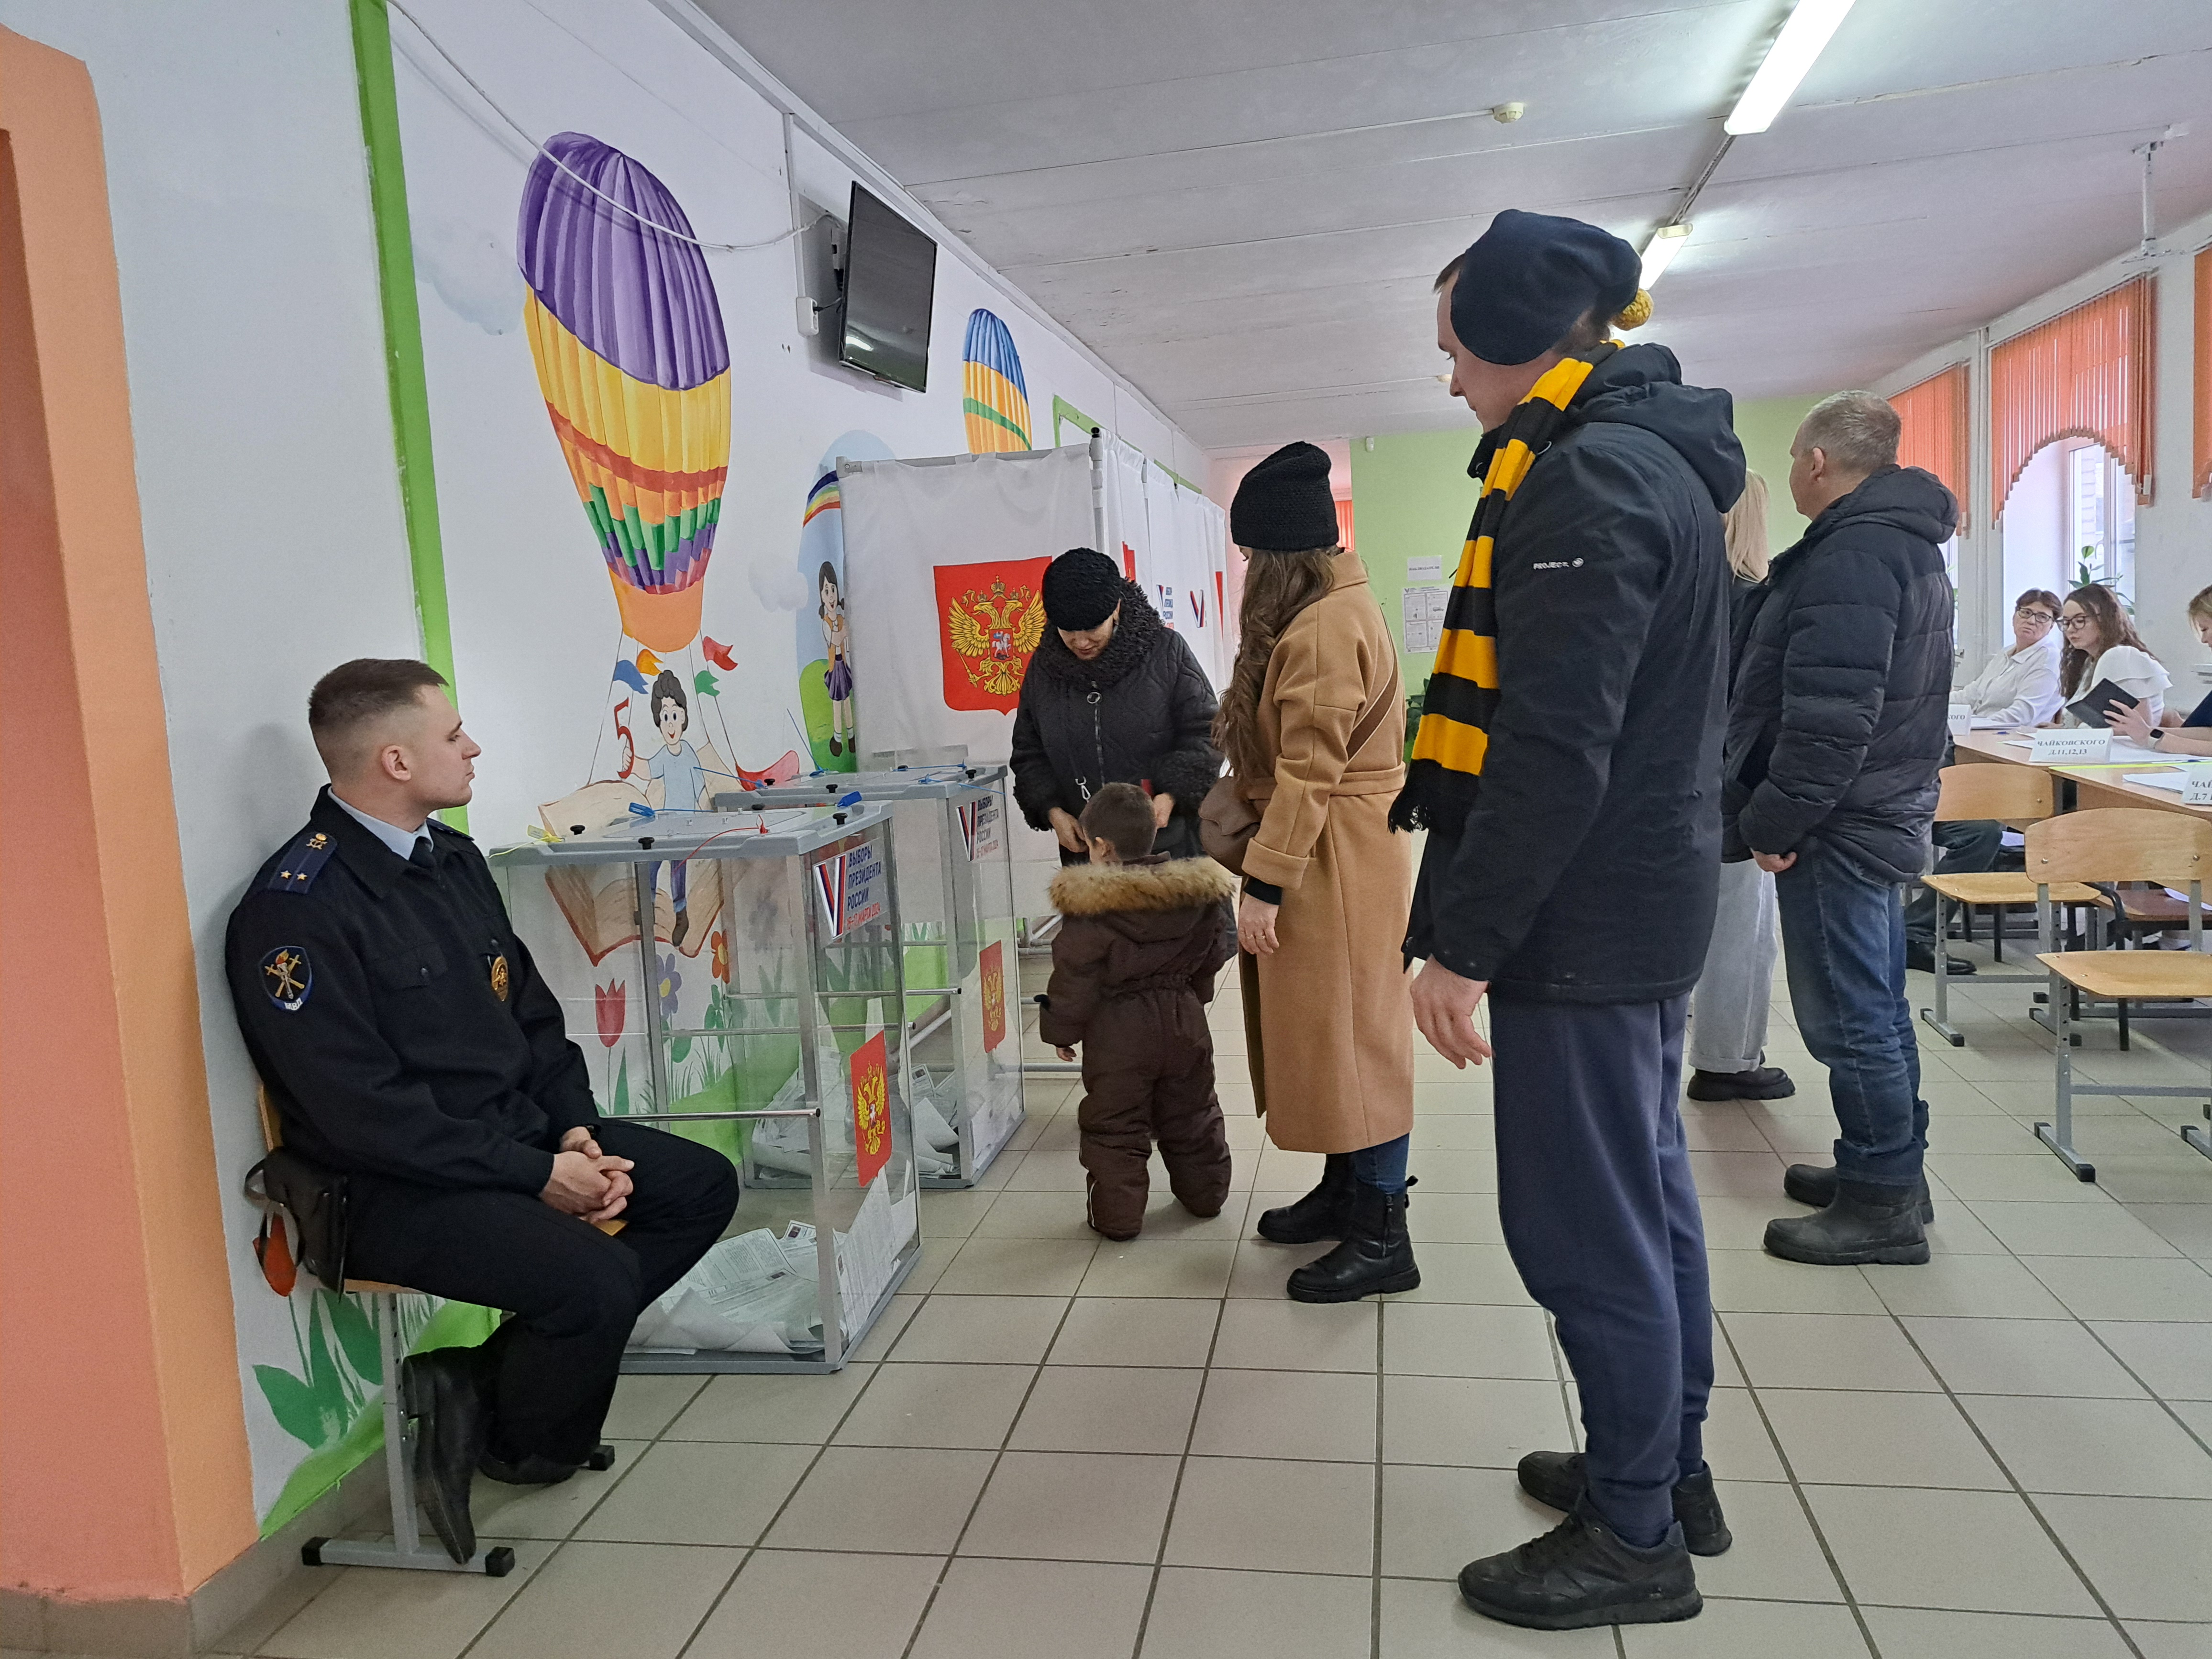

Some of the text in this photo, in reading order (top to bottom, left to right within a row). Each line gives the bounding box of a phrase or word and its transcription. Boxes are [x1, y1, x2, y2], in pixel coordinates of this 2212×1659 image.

[614, 696, 634, 779] 5
[849, 845, 873, 868] ВЫБОРЫ
[848, 861, 881, 890] ПРЕЗИДЕНТА
[847, 887, 869, 911] РОССИИ
[284, 997, 303, 1010] МВД
